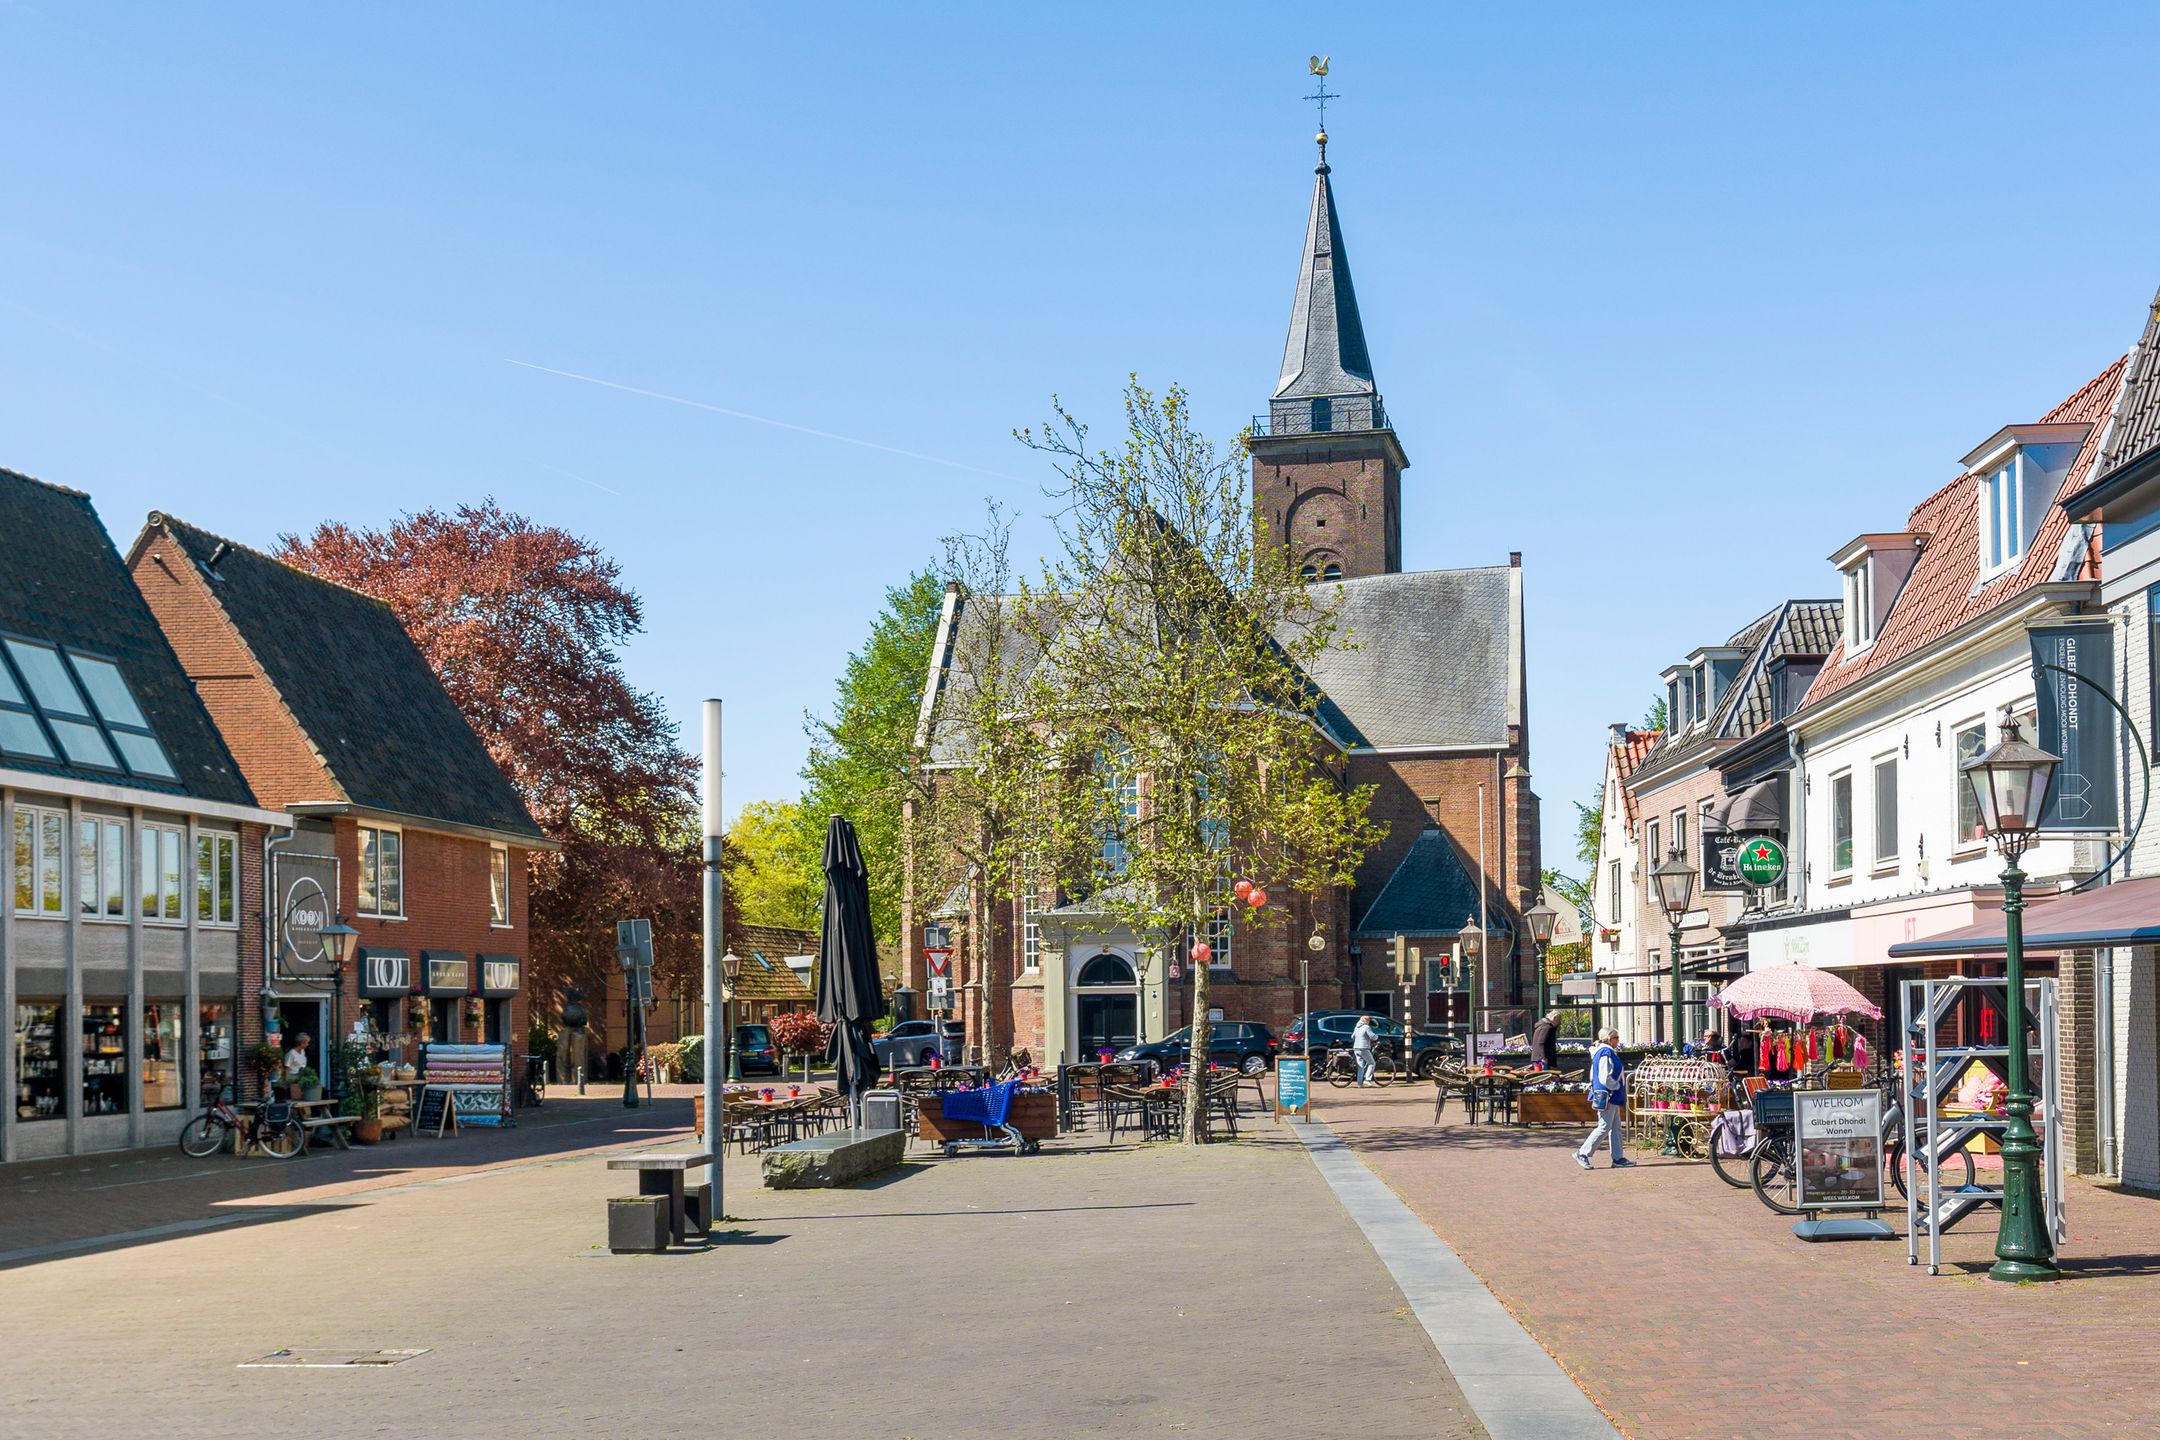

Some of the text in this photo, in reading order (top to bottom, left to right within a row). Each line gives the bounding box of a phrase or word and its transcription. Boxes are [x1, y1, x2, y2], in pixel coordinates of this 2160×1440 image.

[2067, 683, 2078, 731] DHONDT
[1743, 863, 1782, 871] Heineken
[1980, 1008, 1994, 1038] JET
[1811, 1097, 1864, 1108] WELKOM
